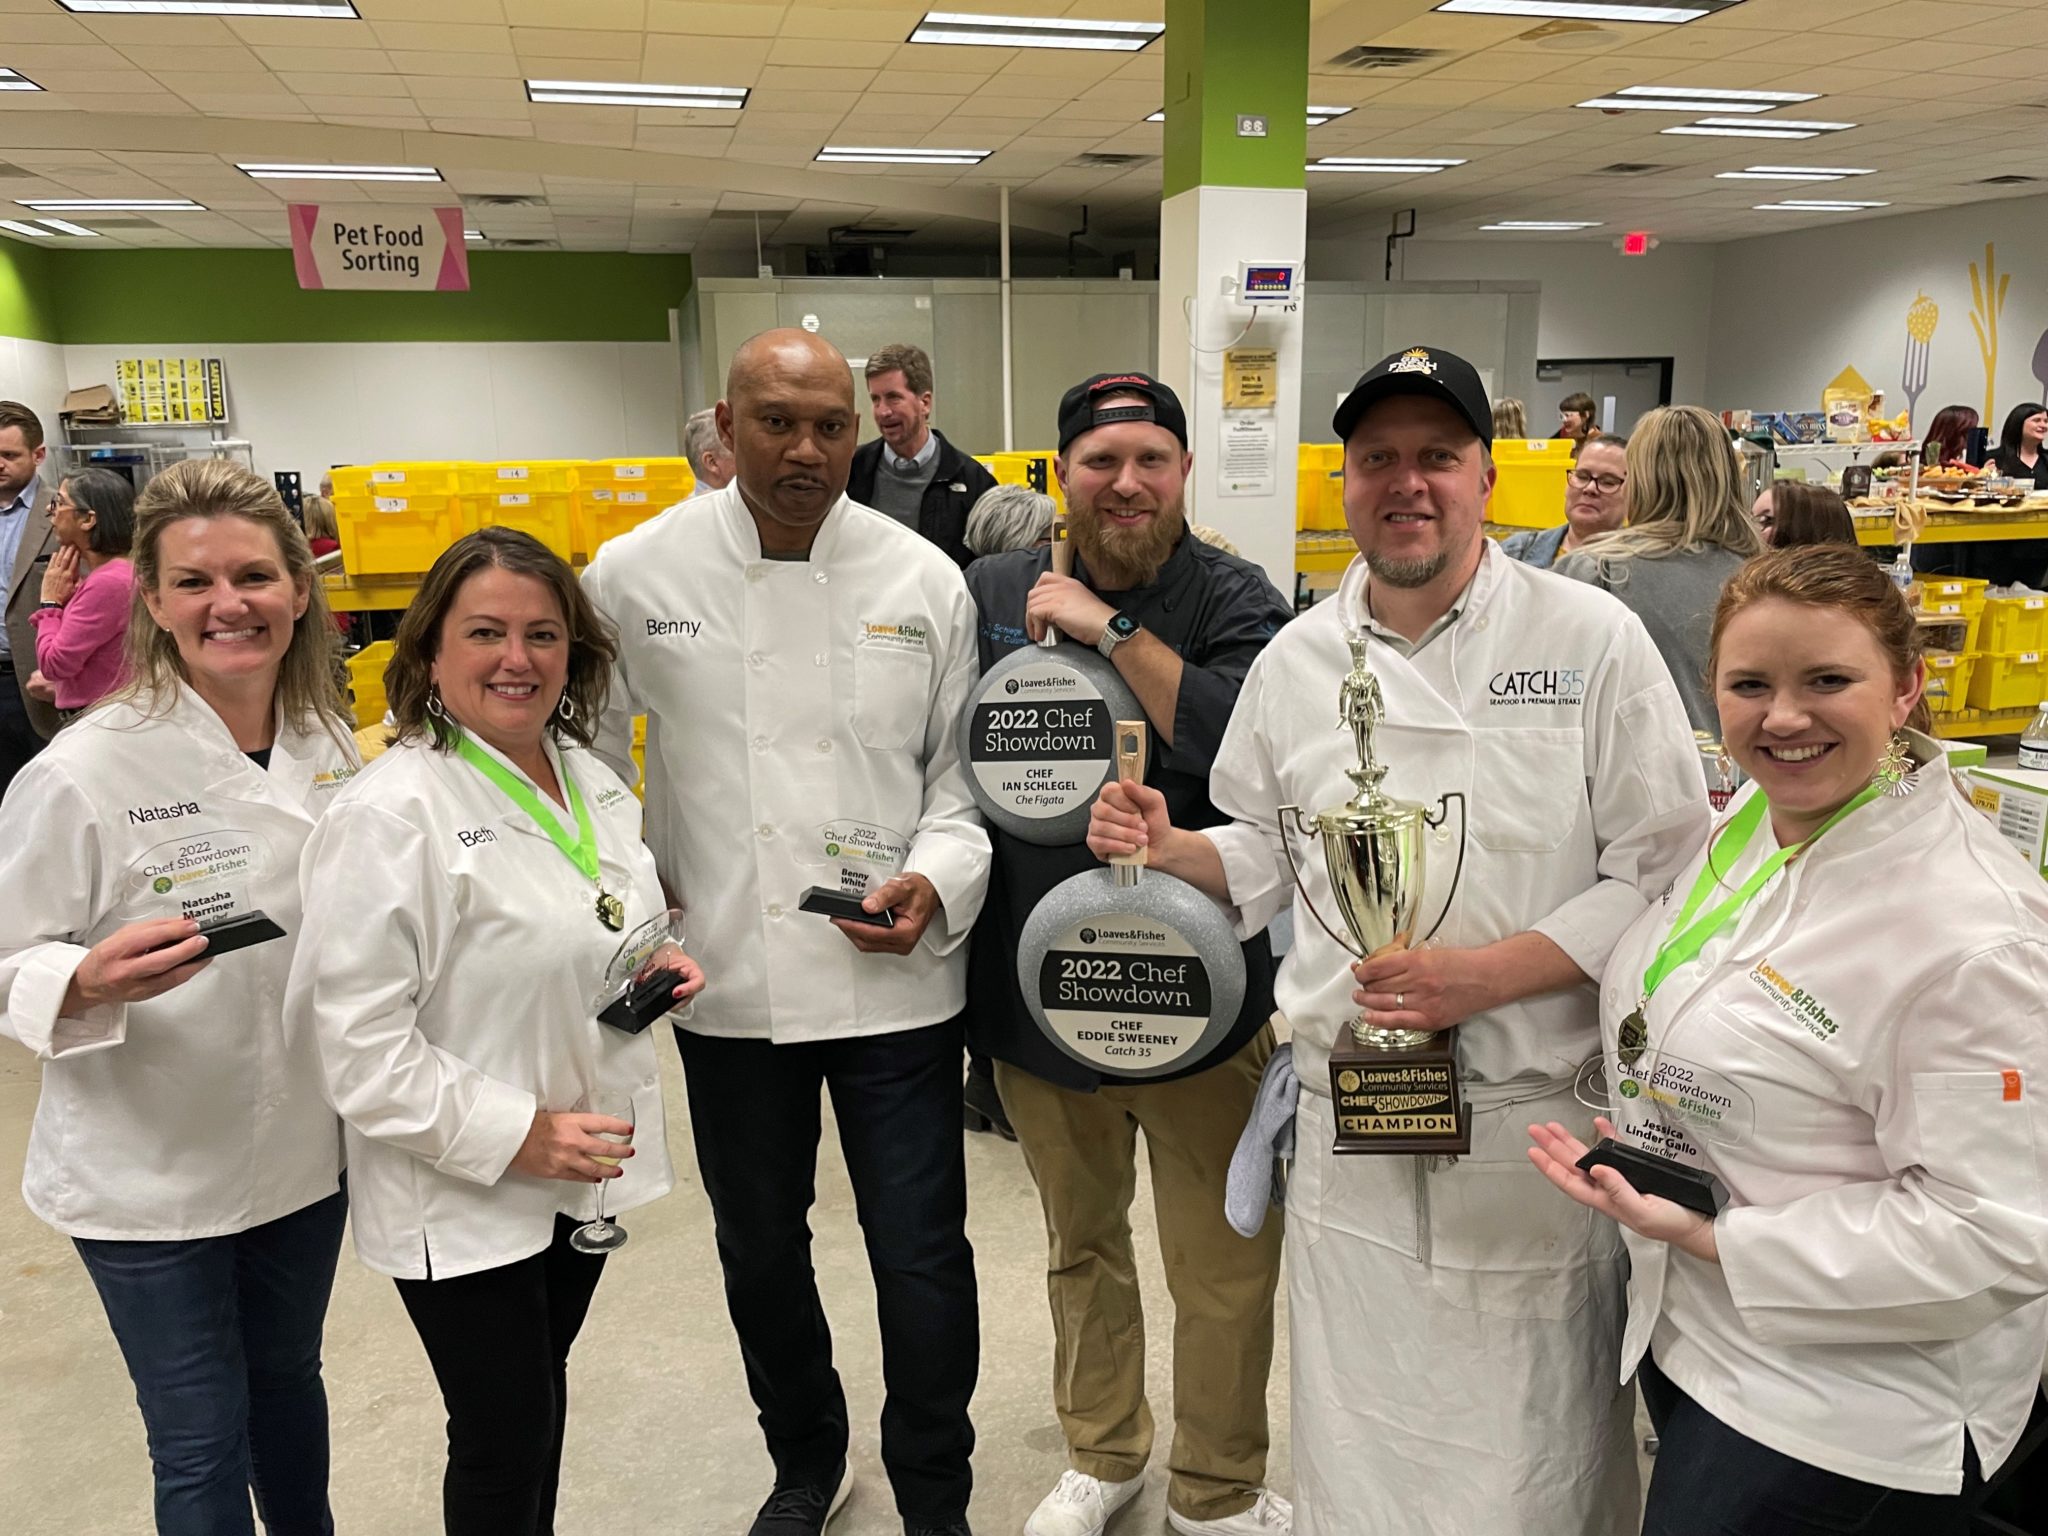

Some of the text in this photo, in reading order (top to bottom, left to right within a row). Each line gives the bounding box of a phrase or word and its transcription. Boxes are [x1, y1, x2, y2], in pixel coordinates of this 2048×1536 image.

[334, 223, 424, 246] Pet Food
[342, 249, 420, 277] Sorting
[210, 362, 223, 417] SAFETY TIPS
[646, 618, 701, 638] Benny
[866, 623, 926, 638] Loaves&Fishes
[1020, 678, 1076, 688] Loaves&Fishes
[1490, 698, 1520, 706] SEAFOOD
[988, 708, 1093, 730] 2022 Chef
[985, 731, 1096, 752] Showdown
[1026, 769, 1054, 778] CHEF
[1002, 781, 1078, 792] IAN SCHLEGEL
[1016, 795, 1064, 806] Che Figata
[128, 802, 201, 824] Natasha
[458, 826, 498, 847] Beth
[824, 831, 901, 854] Chef Showdown
[854, 828, 877, 840] 2022
[179, 842, 212, 857] 2022
[144, 844, 251, 877] Chef Showdown
[172, 858, 248, 884] Loaves&Fishes
[842, 868, 870, 880] Benny
[841, 877, 866, 888] White
[182, 891, 232, 910] Natasha
[183, 900, 236, 920] Marriner
[1098, 928, 1166, 941] Loaves&Fishes
[1098, 938, 1137, 946] Community
[623, 944, 639, 959] Chef
[1060, 958, 1187, 984] 2022 Chef
[1059, 980, 1192, 1006] Showdown
[1756, 958, 1840, 1034] Loaves&Fishes
[1749, 970, 1828, 1042] Community Services
[1110, 1020, 1143, 1030] CHEF
[1077, 1030, 1178, 1045] EDDIE SWEENEY
[1104, 1045, 1152, 1057] Catch 35
[1361, 1069, 1448, 1083] Loaves&Fishes
[1658, 1062, 1694, 1082] 2022
[1362, 1081, 1448, 1092] Community Services
[1617, 1062, 1732, 1108] Chef Showdown
[1344, 1118, 1452, 1130] CHAMPION
[1642, 1118, 1684, 1140] Jessica
[1626, 1124, 1697, 1156] Linder Gallo
[1640, 1142, 1678, 1160] Sous Chef
